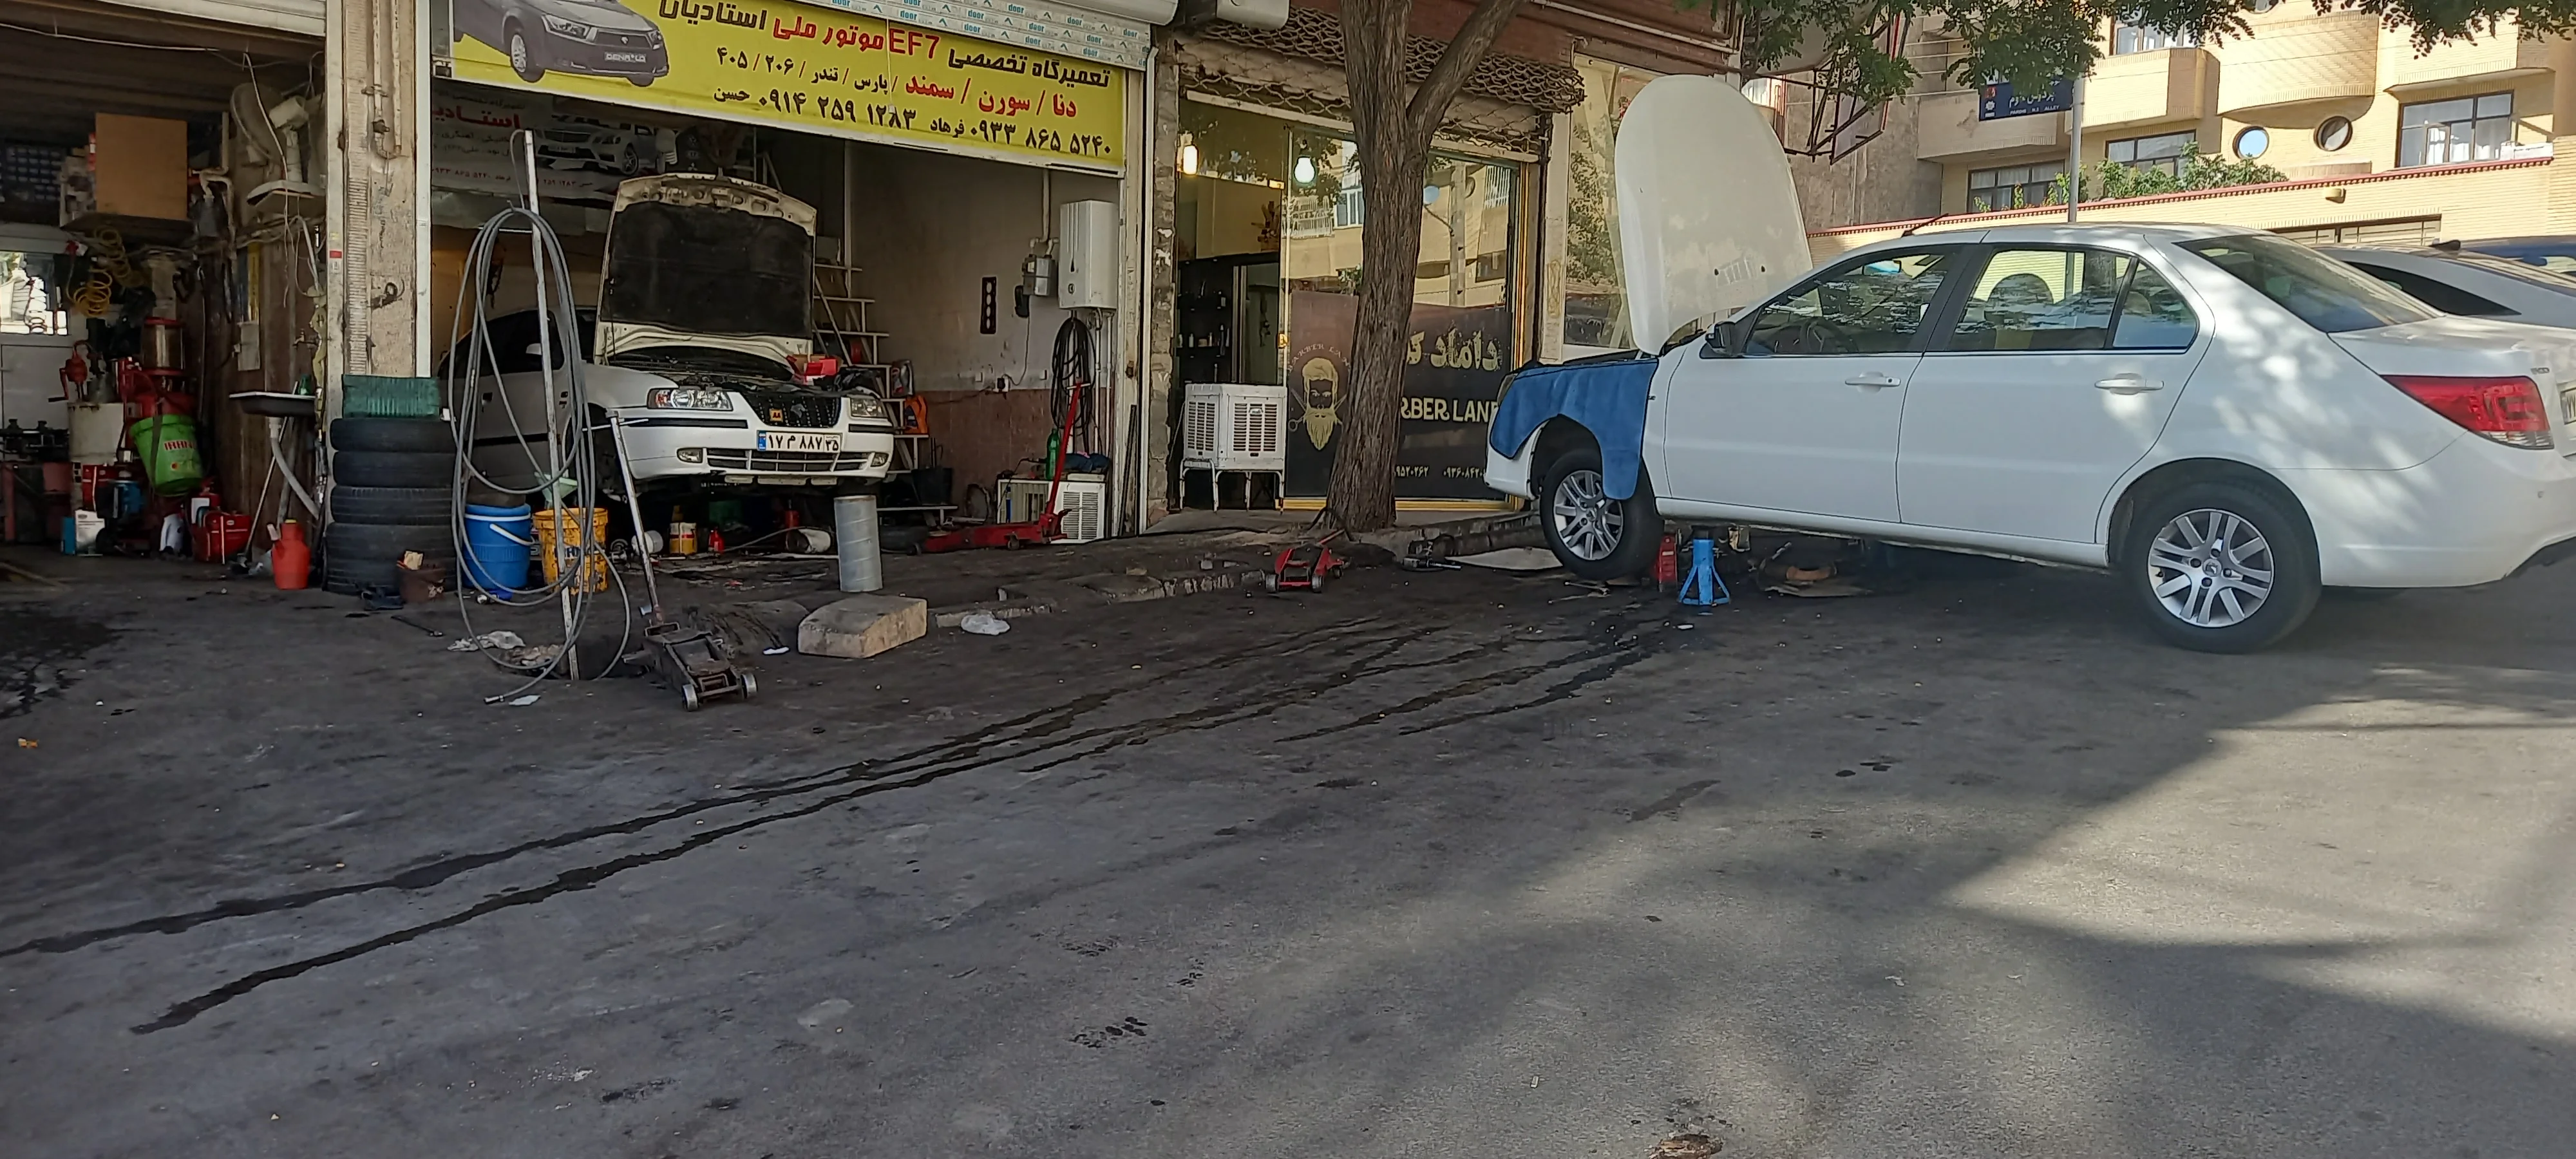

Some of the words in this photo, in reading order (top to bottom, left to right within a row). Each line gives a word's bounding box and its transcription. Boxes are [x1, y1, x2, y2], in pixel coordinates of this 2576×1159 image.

[659, 0, 767, 30] استادیان
[773, 16, 817, 40] ملی
[822, 25, 884, 52] موتور
[889, 28, 940, 59] EF7
[717, 47, 748, 69] ۴۰۵
[765, 55, 794, 75] ۲۰۶
[949, 48, 1028, 75] تخصصی
[811, 67, 838, 84] تندر
[854, 73, 887, 95] پارس
[1032, 59, 1111, 88] تعمیرگاه
[714, 88, 750, 102] حسن
[905, 75, 954, 99] سمند
[759, 88, 807, 115] ۰۹۱۴
[817, 96, 857, 123] ۲۵۹
[978, 91, 1030, 117] سورن
[1053, 93, 1077, 117] دنا
[867, 103, 916, 129] ۱۲۸۳
[931, 117, 965, 138] فرهاد
[971, 119, 1016, 144] ۰۹۳۳
[1025, 127, 1061, 152] ۸۶۵
[1070, 133, 1111, 156] ۵۲۴۰
[1329, 346, 1351, 369] LAN
[768, 435, 783, 449] ۱۷
[799, 435, 822, 449] ۸۸۷
[826, 439, 839, 451] ۳۵
